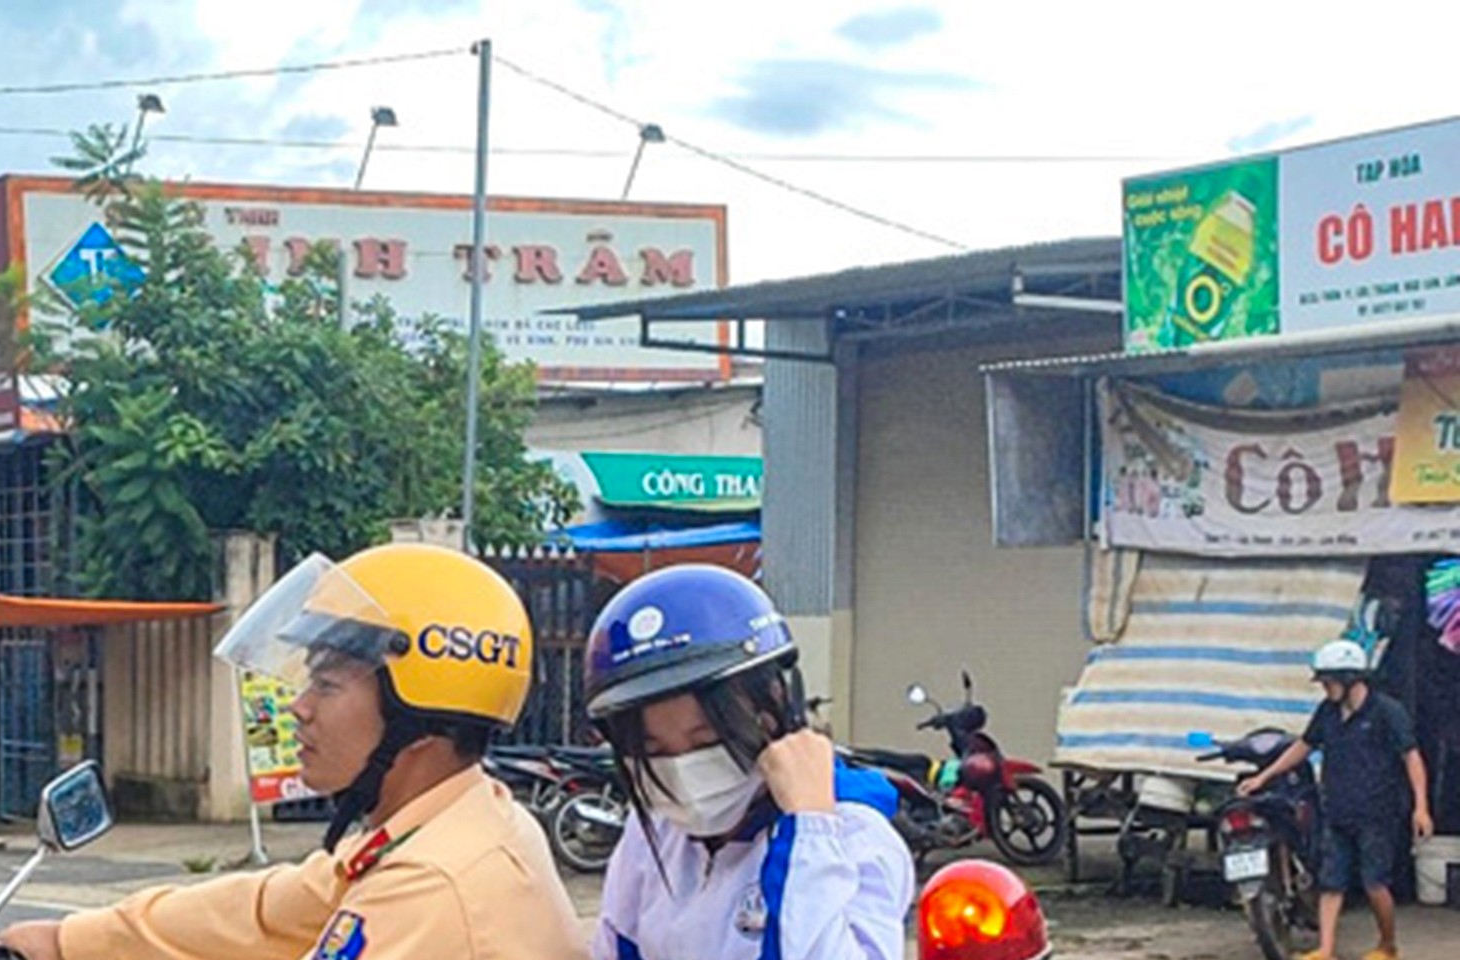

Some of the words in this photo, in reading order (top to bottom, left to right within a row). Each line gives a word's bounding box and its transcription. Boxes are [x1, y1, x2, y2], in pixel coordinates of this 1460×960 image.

[453, 229, 696, 287] TRÂM
[1318, 202, 1373, 264] CÔ
[642, 468, 704, 496] CÔNG
[418, 623, 520, 668] CSGT
